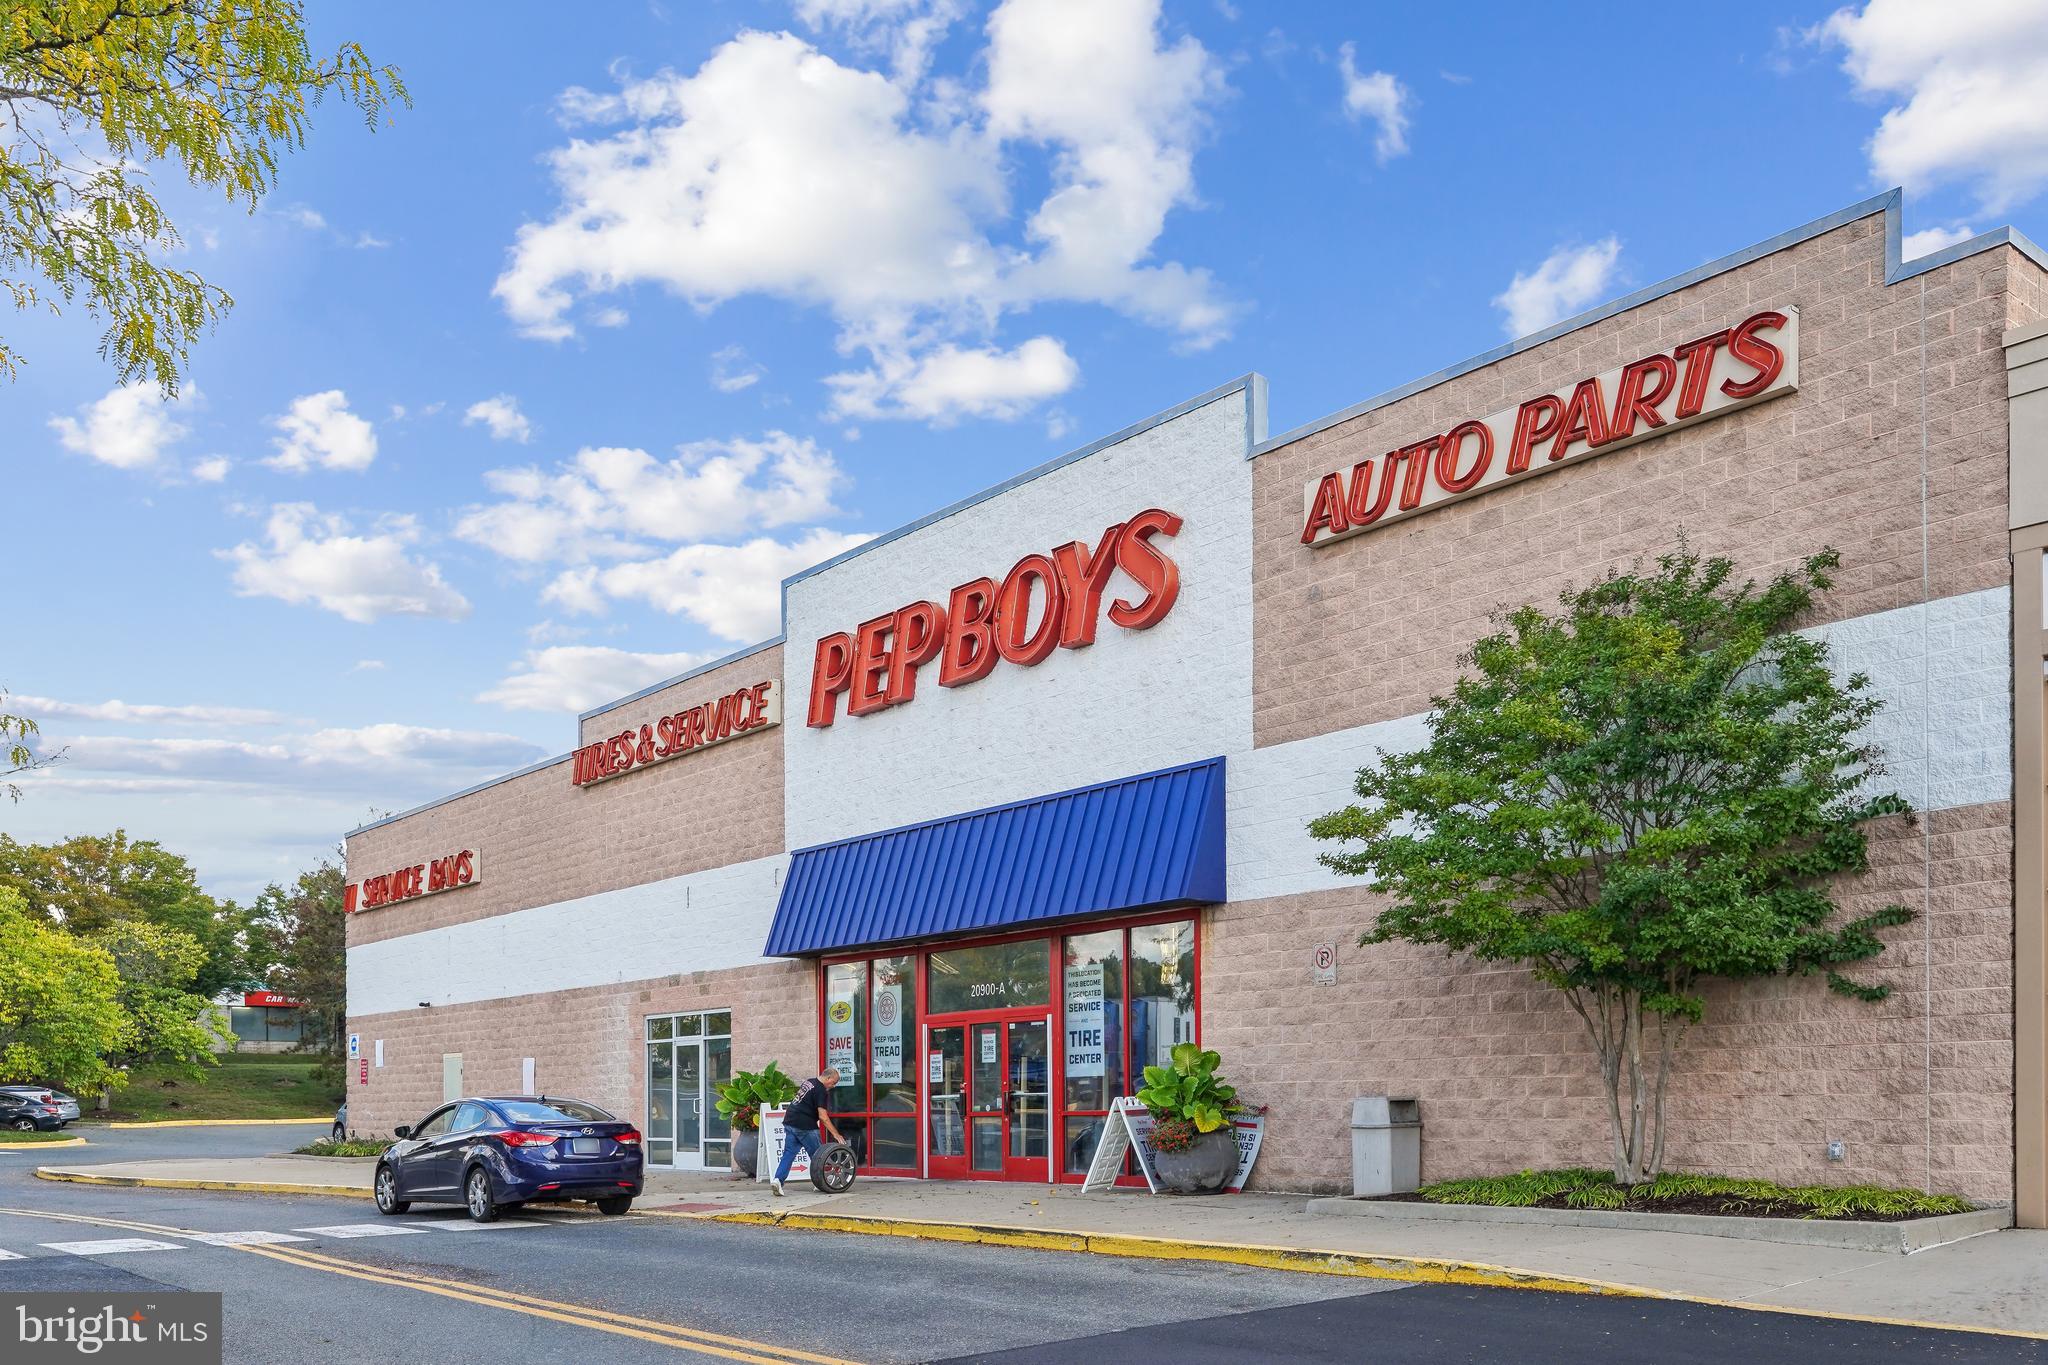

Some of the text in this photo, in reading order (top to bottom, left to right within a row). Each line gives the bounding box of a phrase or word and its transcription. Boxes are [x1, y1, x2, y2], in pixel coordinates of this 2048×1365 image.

[1301, 311, 1787, 544] AUTO PARTS
[572, 730, 636, 785] TIRES
[655, 681, 772, 758] SERVICE
[362, 865, 425, 908] SERVICE
[428, 850, 473, 891] BAYS
[971, 982, 1006, 997] 20900-A
[1080, 979, 1101, 987] BECOME
[265, 995, 283, 1003] CAR
[1069, 1001, 1101, 1012] SERVICE
[829, 1037, 852, 1050] SAVE
[1069, 1029, 1101, 1047] TIRE
[875, 1046, 900, 1057] TREAD
[1069, 1053, 1101, 1064] CENTER
